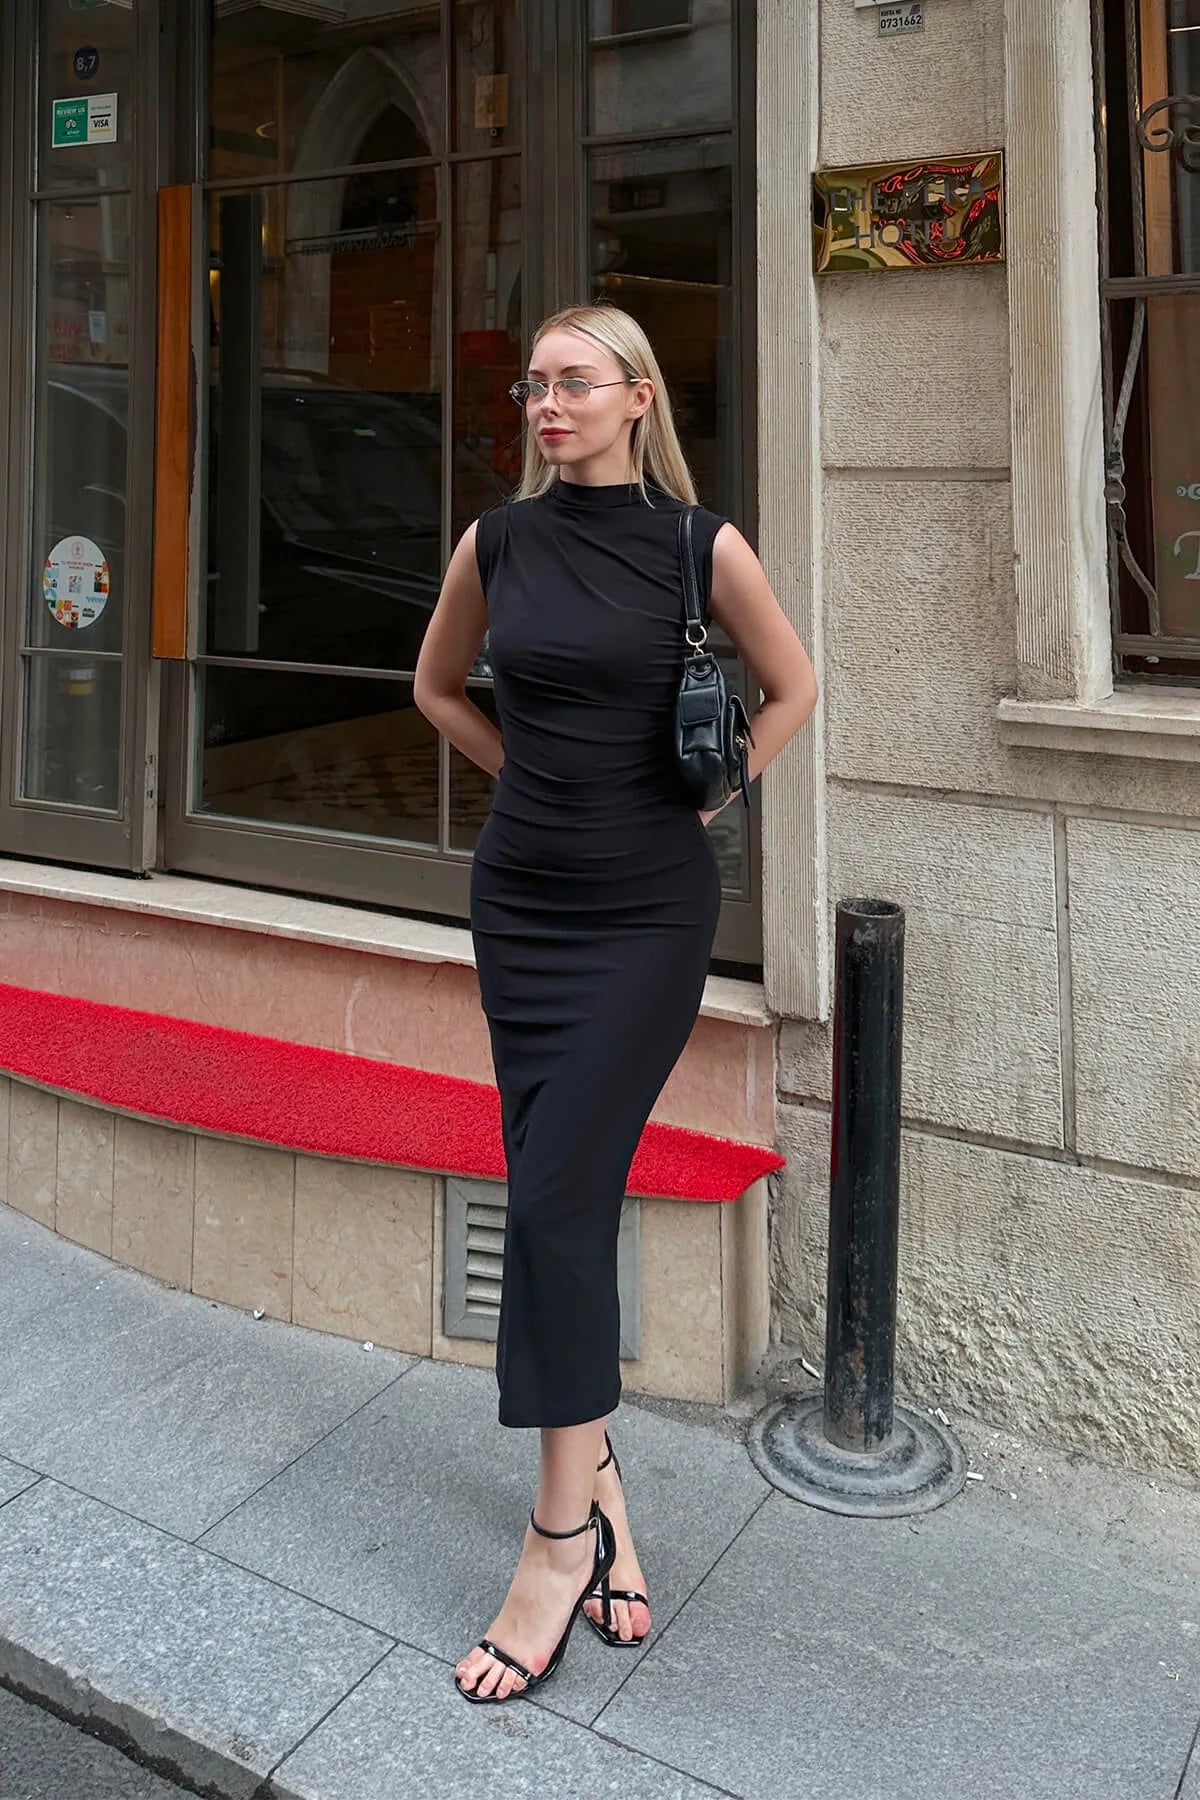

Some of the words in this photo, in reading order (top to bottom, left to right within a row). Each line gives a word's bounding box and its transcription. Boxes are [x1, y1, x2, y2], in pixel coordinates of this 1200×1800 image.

[880, 15, 922, 29] 0731662
[76, 55, 96, 72] 8,7
[93, 119, 109, 128] VISA
[827, 184, 884, 212] THE
[855, 219, 955, 249] HOTEL
